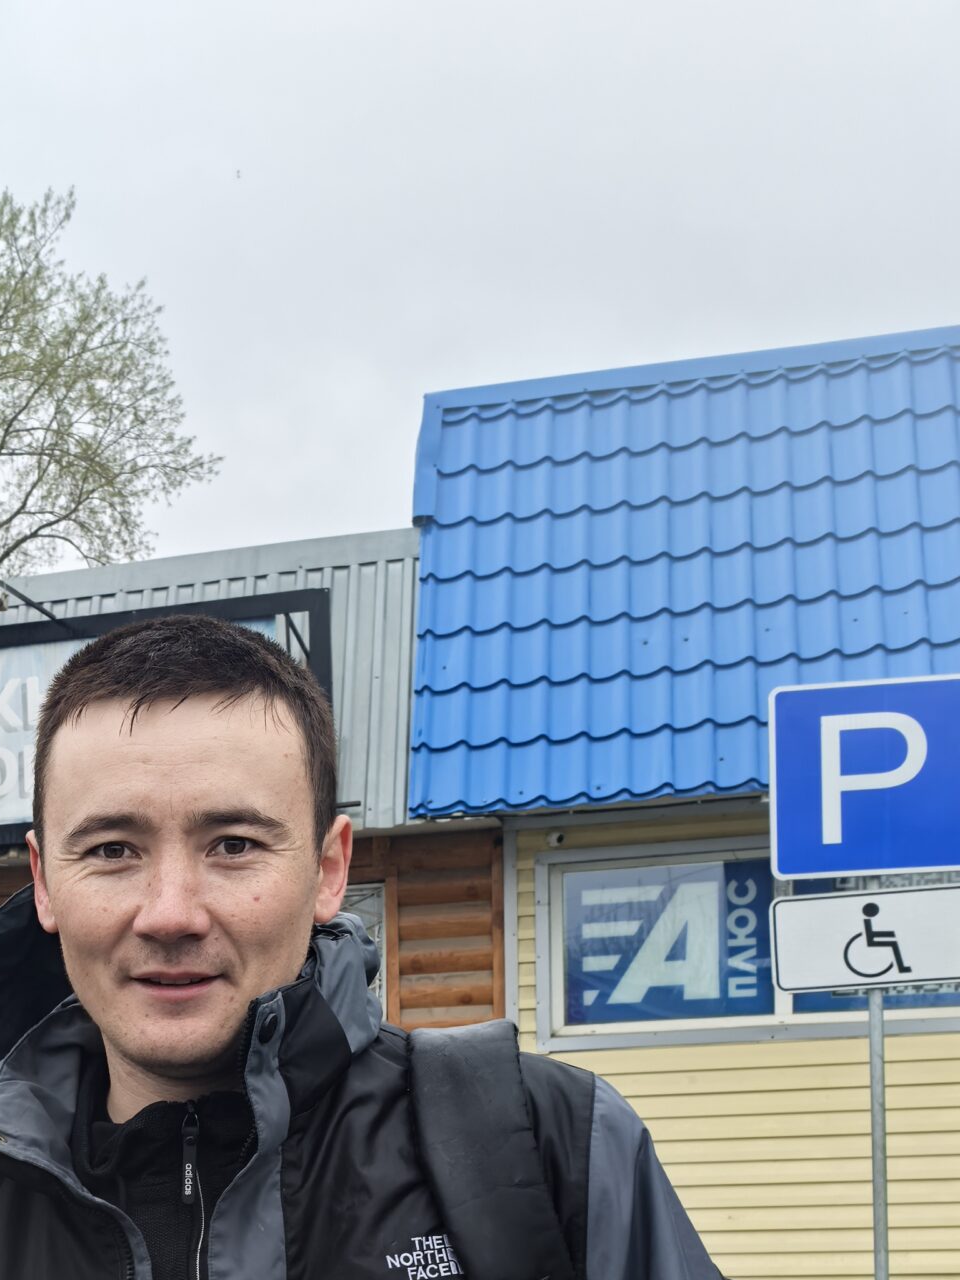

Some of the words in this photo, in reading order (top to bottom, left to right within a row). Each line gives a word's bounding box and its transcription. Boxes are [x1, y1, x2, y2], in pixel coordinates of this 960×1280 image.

[820, 711, 928, 845] P
[726, 877, 758, 999] ПЛЮС
[184, 1163, 193, 1195] adidas
[411, 1235, 445, 1251] THE
[385, 1248, 448, 1269] NORTH
[407, 1262, 452, 1280] FACE
